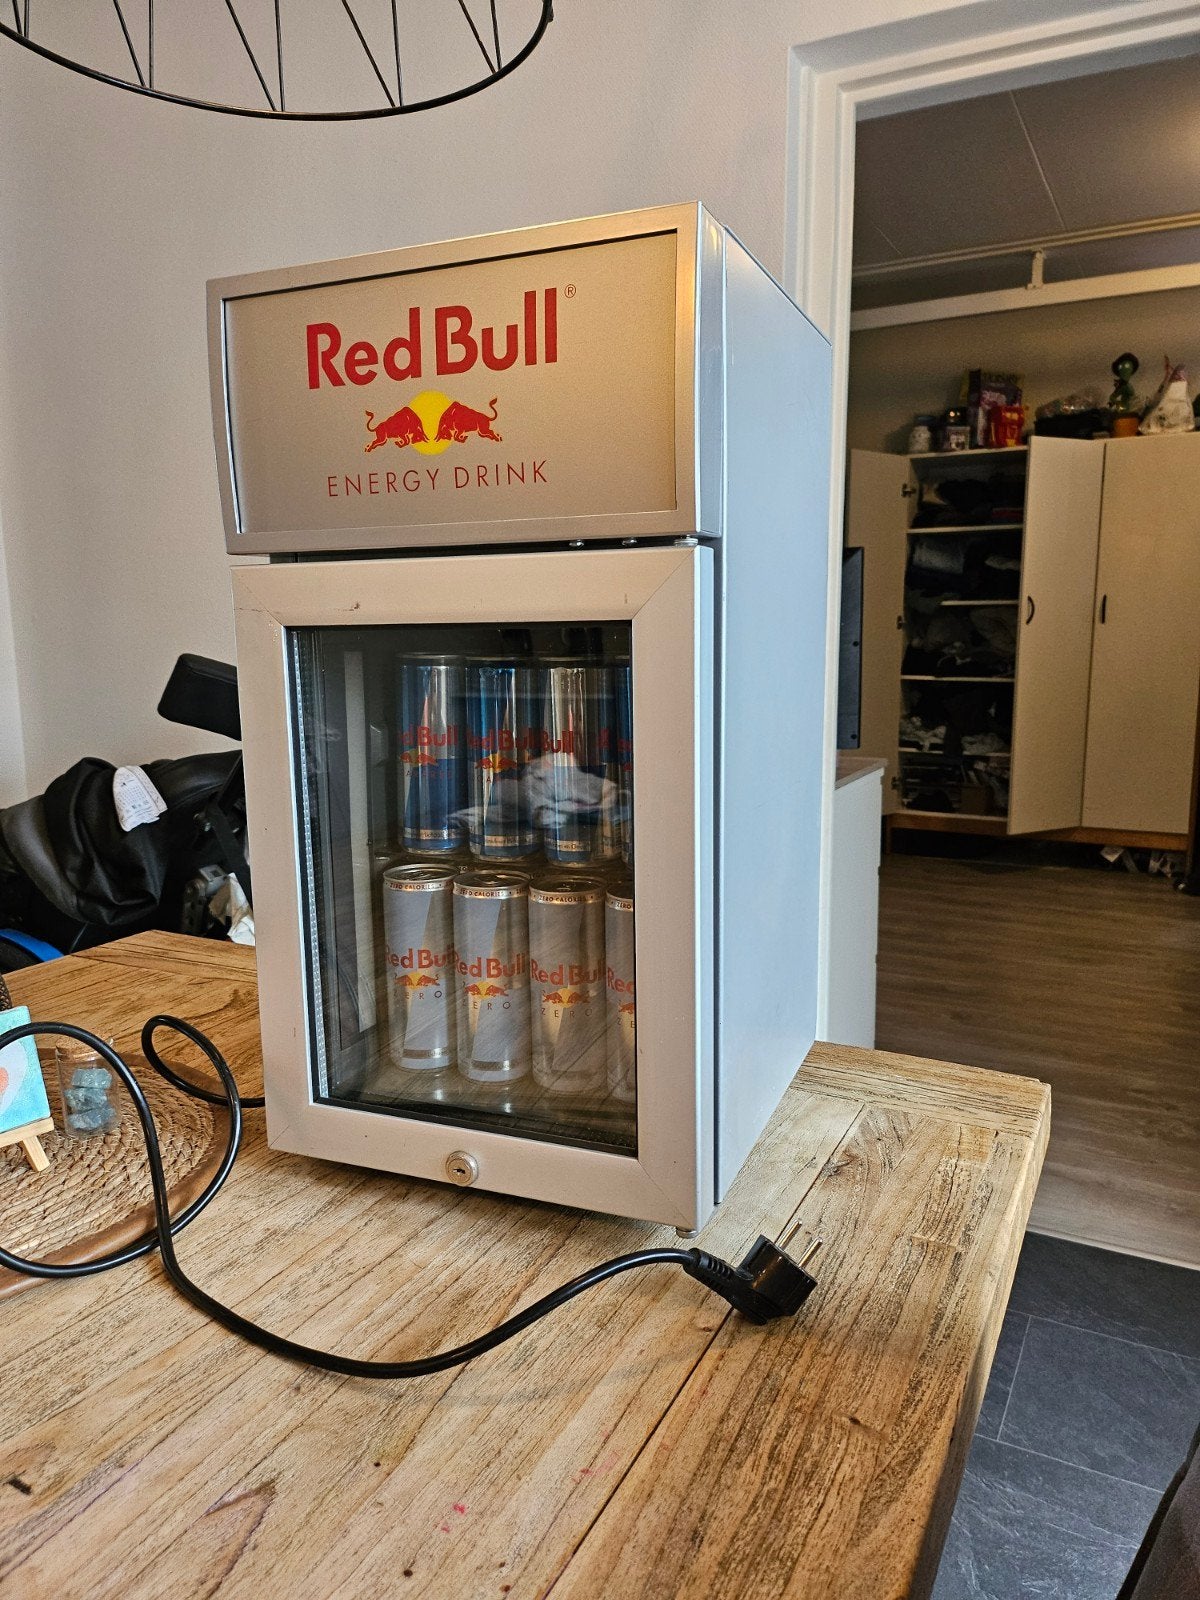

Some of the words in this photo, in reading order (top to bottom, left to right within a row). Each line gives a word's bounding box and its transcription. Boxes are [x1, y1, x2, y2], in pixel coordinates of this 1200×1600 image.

[306, 306, 422, 389] Red
[434, 287, 558, 376] Bull
[327, 468, 440, 497] ENERGY
[454, 460, 548, 489] DRINK
[417, 725, 458, 747] Bull
[539, 894, 554, 903] ZERO
[616, 901, 632, 910] ZERO
[486, 952, 526, 979] Bull
[531, 958, 564, 986] Red
[541, 1007, 593, 1018] ZERO
